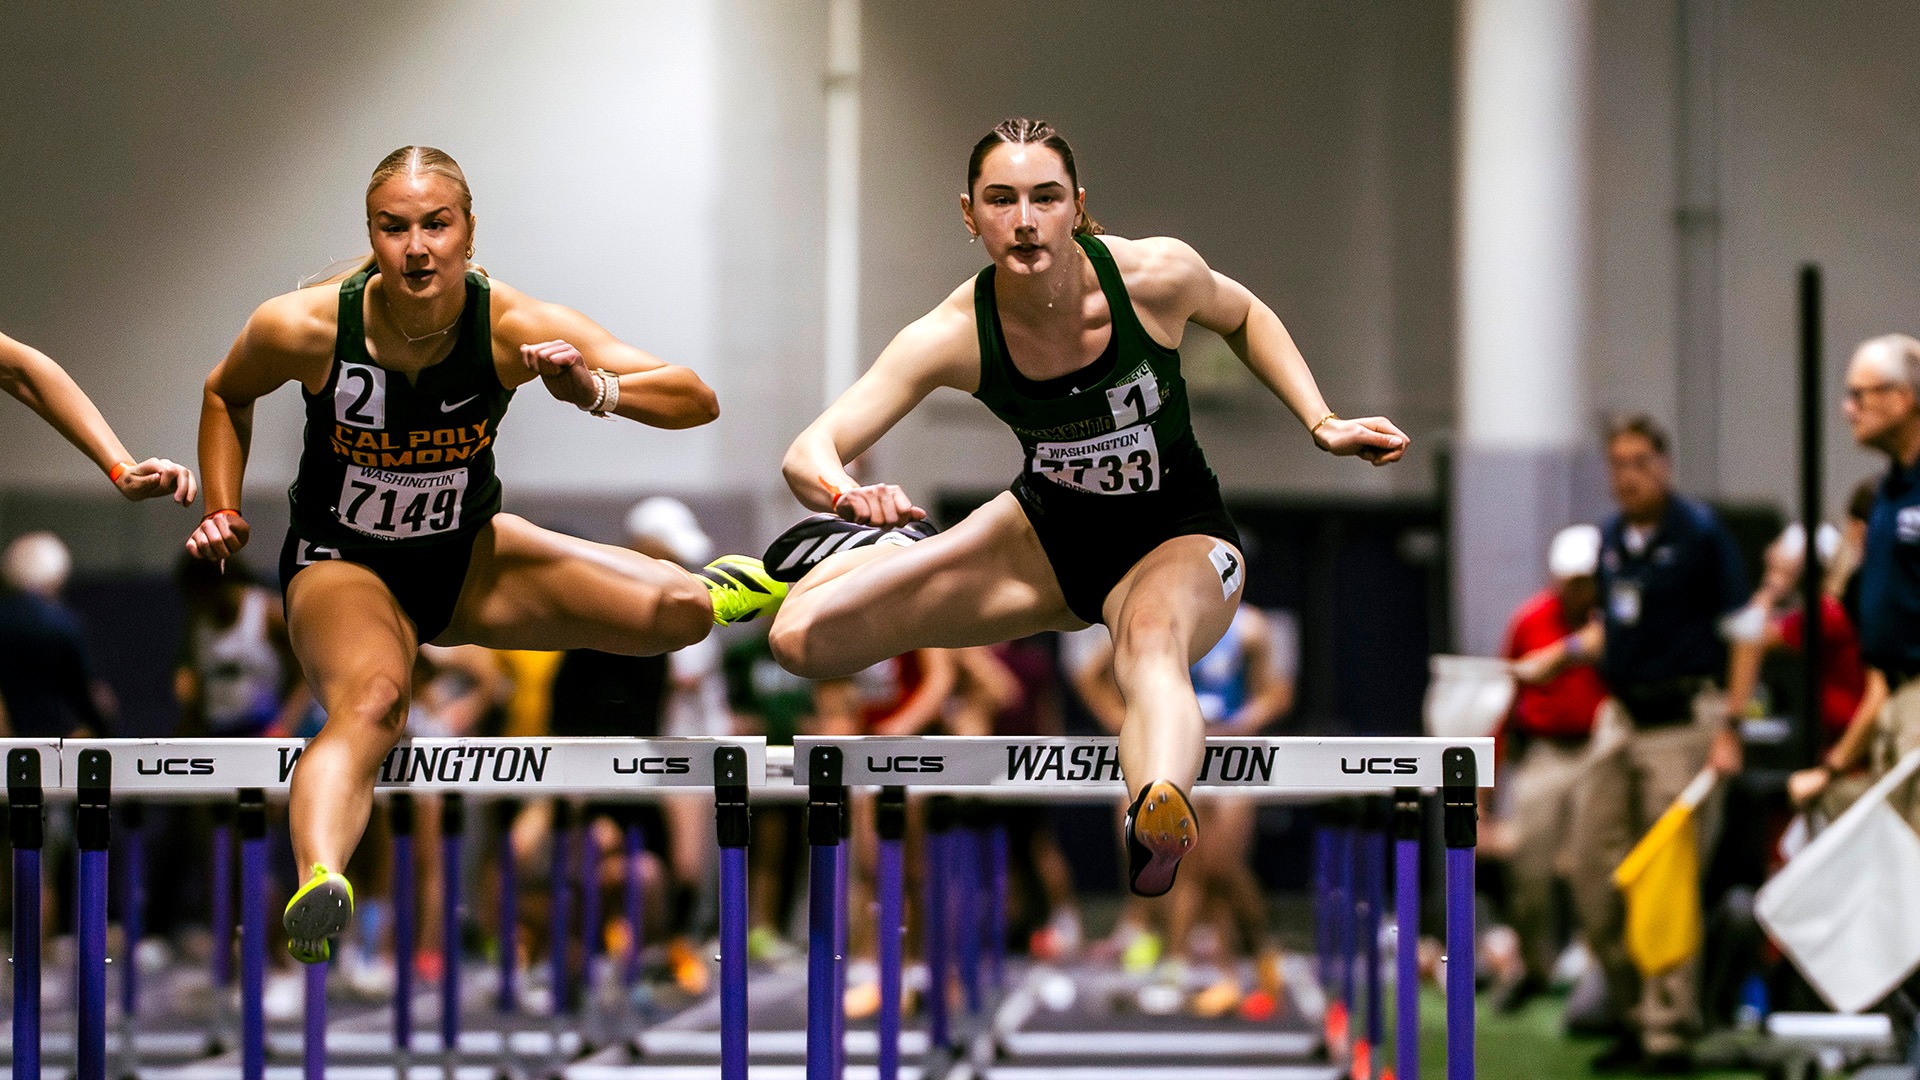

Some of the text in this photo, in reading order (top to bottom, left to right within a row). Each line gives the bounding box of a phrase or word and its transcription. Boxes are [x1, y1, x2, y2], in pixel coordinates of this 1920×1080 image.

[344, 367, 375, 425] 2
[1123, 383, 1147, 420] 1
[335, 418, 489, 450] CAL POLY
[1049, 432, 1140, 459] WASHINGTON
[359, 466, 456, 489] WASHINGTON
[345, 479, 458, 532] 7149
[1221, 552, 1239, 585] 1
[137, 757, 215, 776] UCS
[613, 757, 690, 774] UCS
[867, 755, 945, 773] UCS
[1006, 745, 1280, 783] WASHTON
[1340, 757, 1418, 775] UCS
